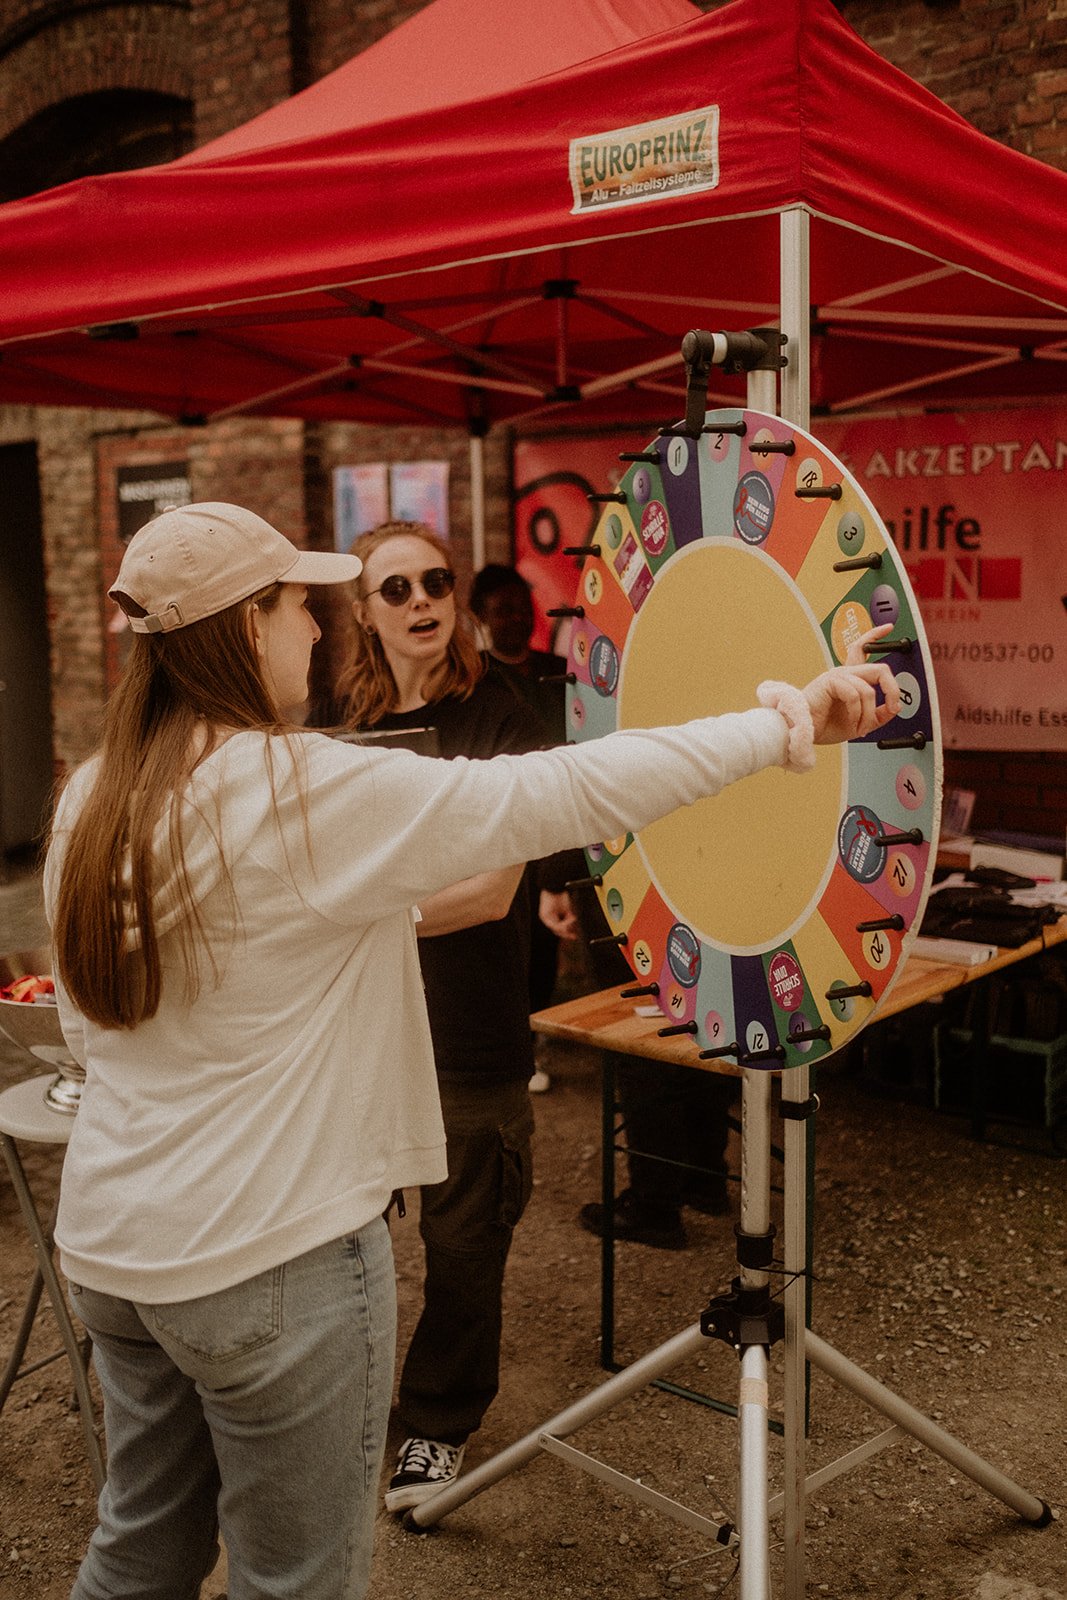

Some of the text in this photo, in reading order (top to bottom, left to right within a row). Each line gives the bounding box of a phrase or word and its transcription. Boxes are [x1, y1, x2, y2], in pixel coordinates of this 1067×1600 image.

[581, 119, 707, 187] EUROPRINZ
[591, 188, 609, 202] Alu
[714, 433, 724, 450] 2
[802, 470, 817, 488] 18
[844, 526, 857, 541] 3
[876, 600, 893, 613] 11
[954, 704, 1033, 727] Aidshilfe
[903, 779, 916, 797] 4
[893, 859, 907, 887] 12
[636, 947, 650, 967] 22
[871, 932, 884, 964] 20
[672, 994, 682, 1009] 14
[753, 1033, 763, 1050] 21
